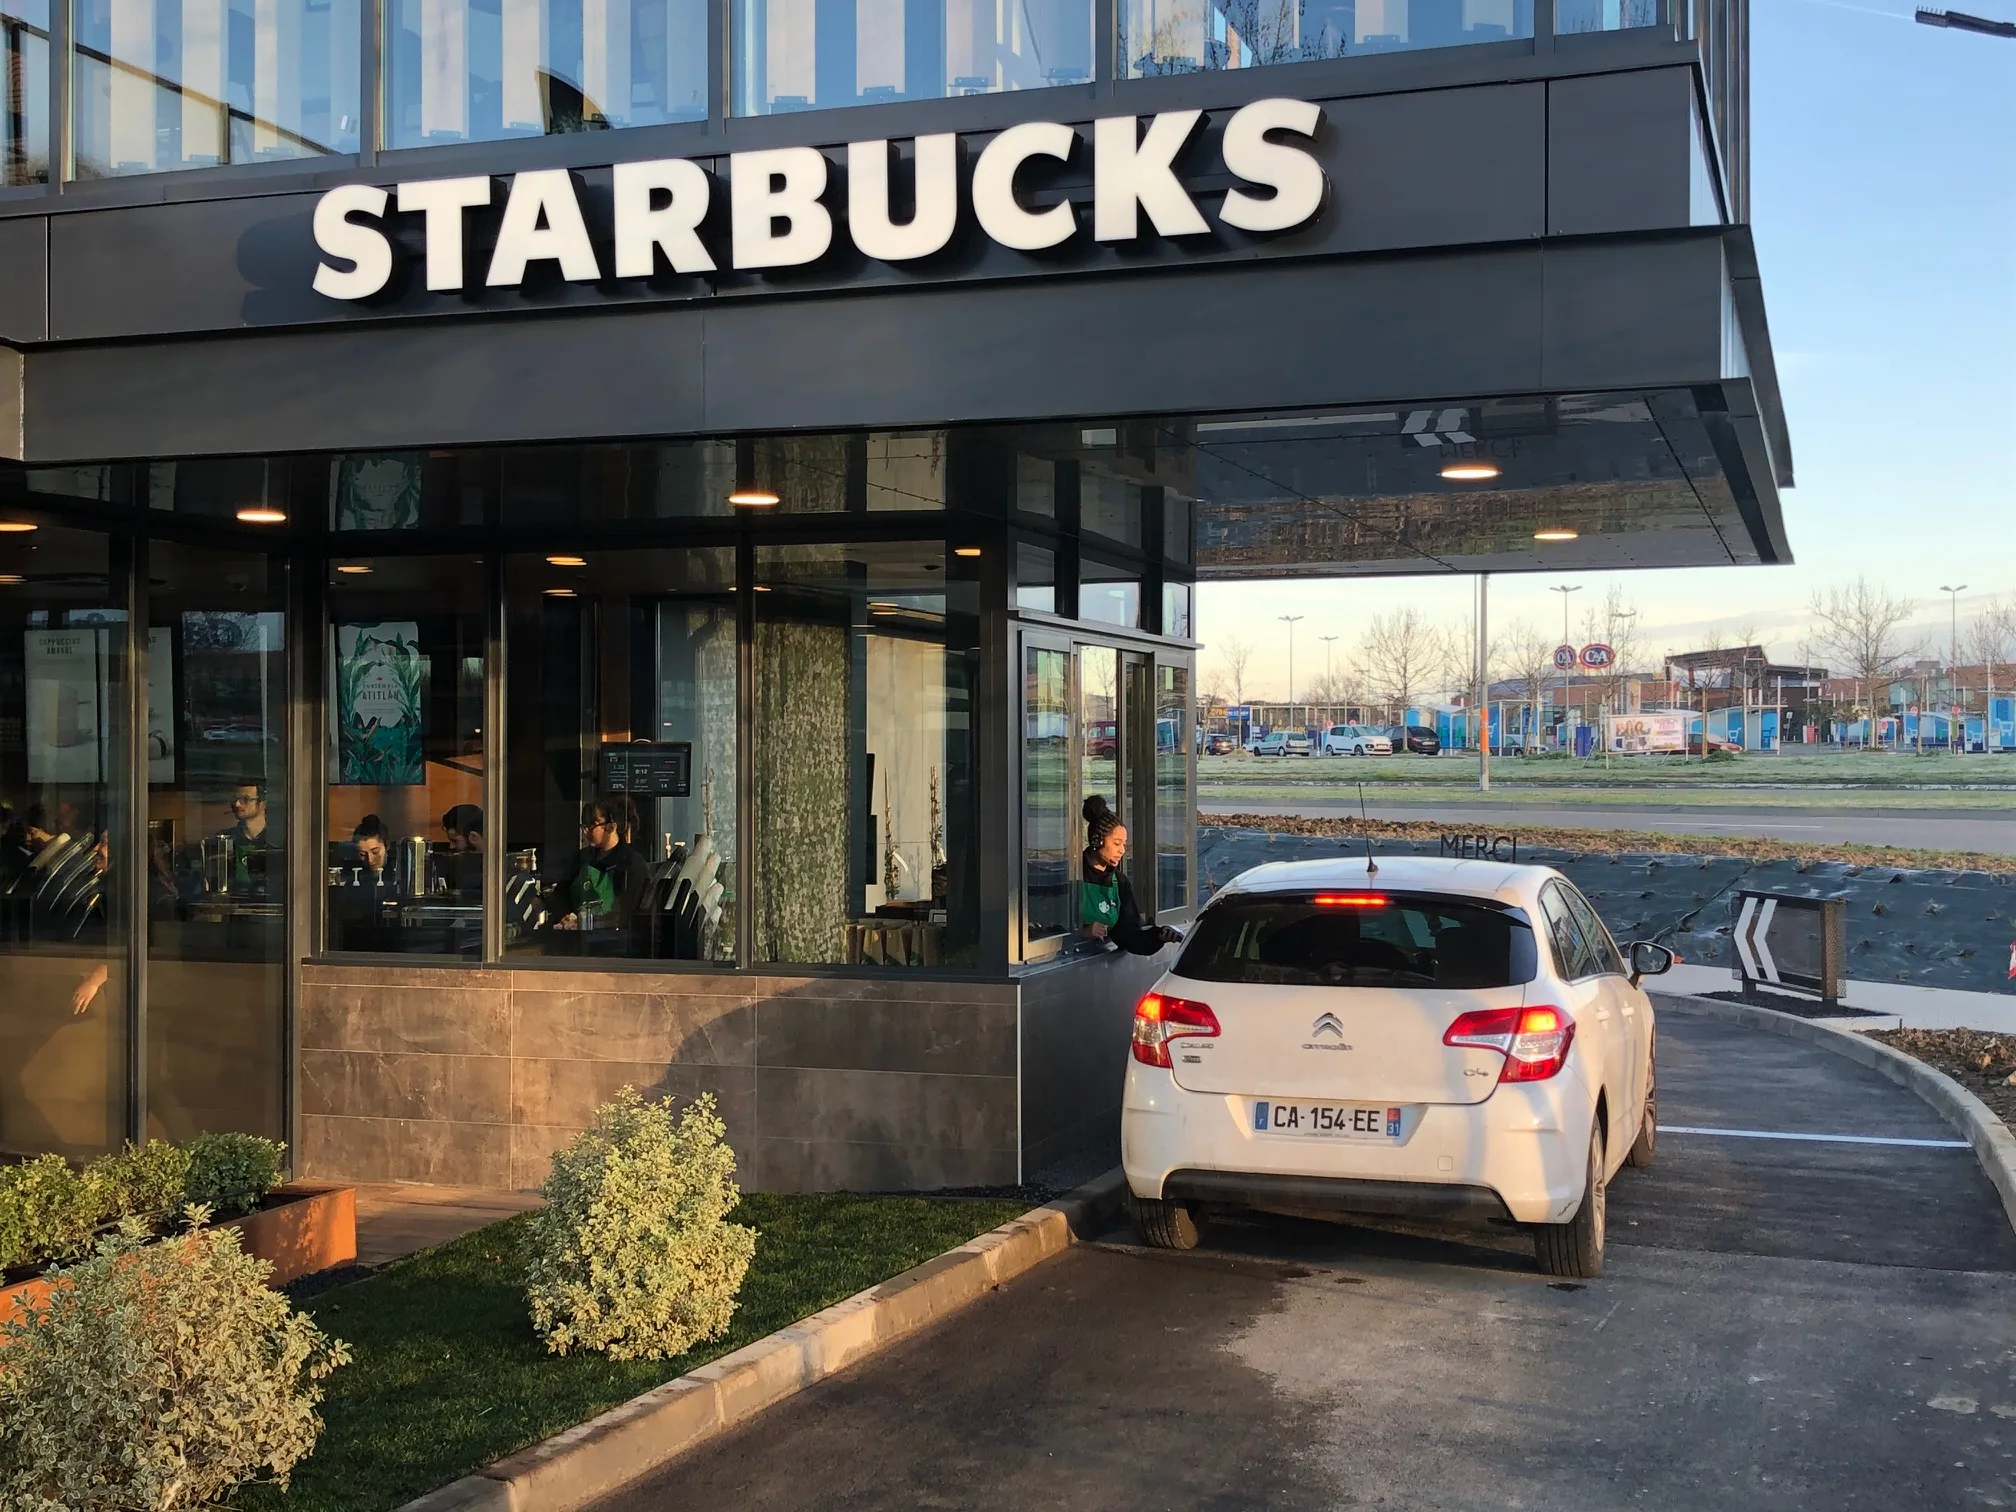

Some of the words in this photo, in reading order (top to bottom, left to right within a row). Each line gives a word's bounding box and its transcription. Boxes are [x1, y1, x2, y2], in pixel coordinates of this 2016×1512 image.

[312, 98, 1325, 301] STARBUCKS
[1440, 834, 1516, 863] MERCI
[1463, 1067, 1489, 1077] C4
[1387, 1122, 1399, 1136] 31
